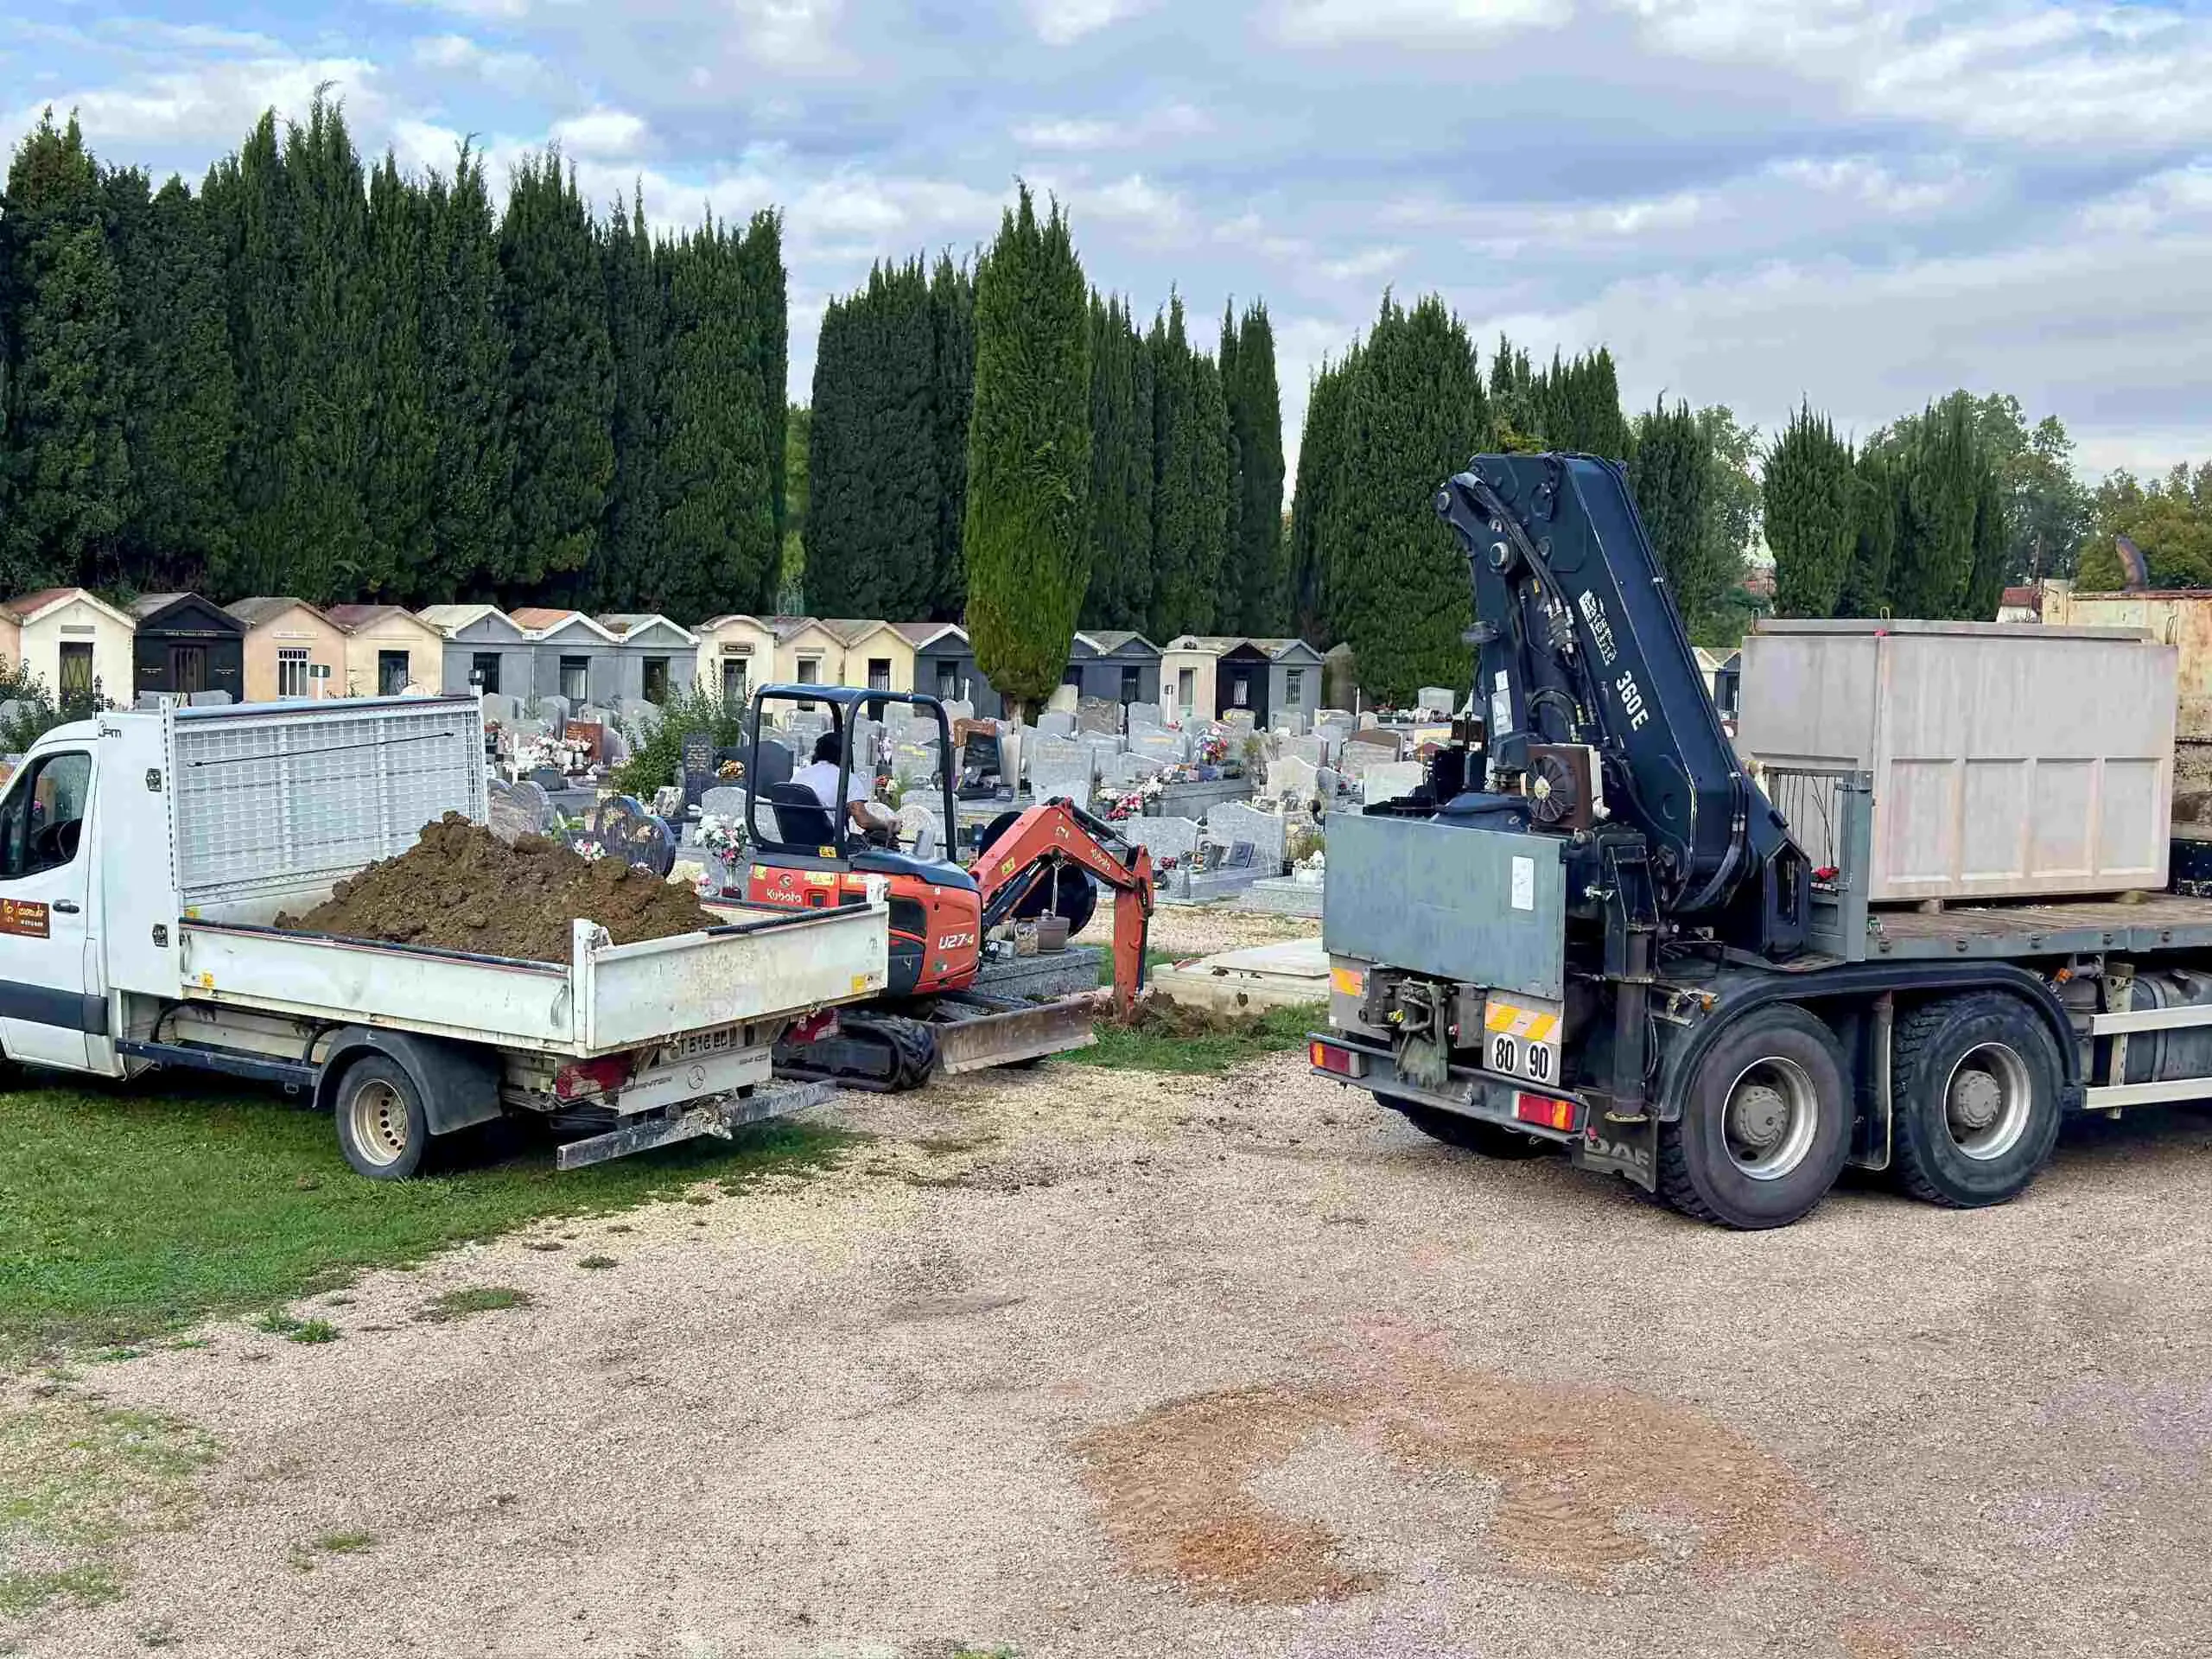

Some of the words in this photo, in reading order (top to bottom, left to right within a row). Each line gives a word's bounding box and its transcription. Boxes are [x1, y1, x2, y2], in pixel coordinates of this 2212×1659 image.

[766, 888, 802, 903] Kubota
[1496, 1038, 1515, 1072] 80
[1529, 1045, 1548, 1079] 90
[1584, 1135, 1650, 1166] DAF
